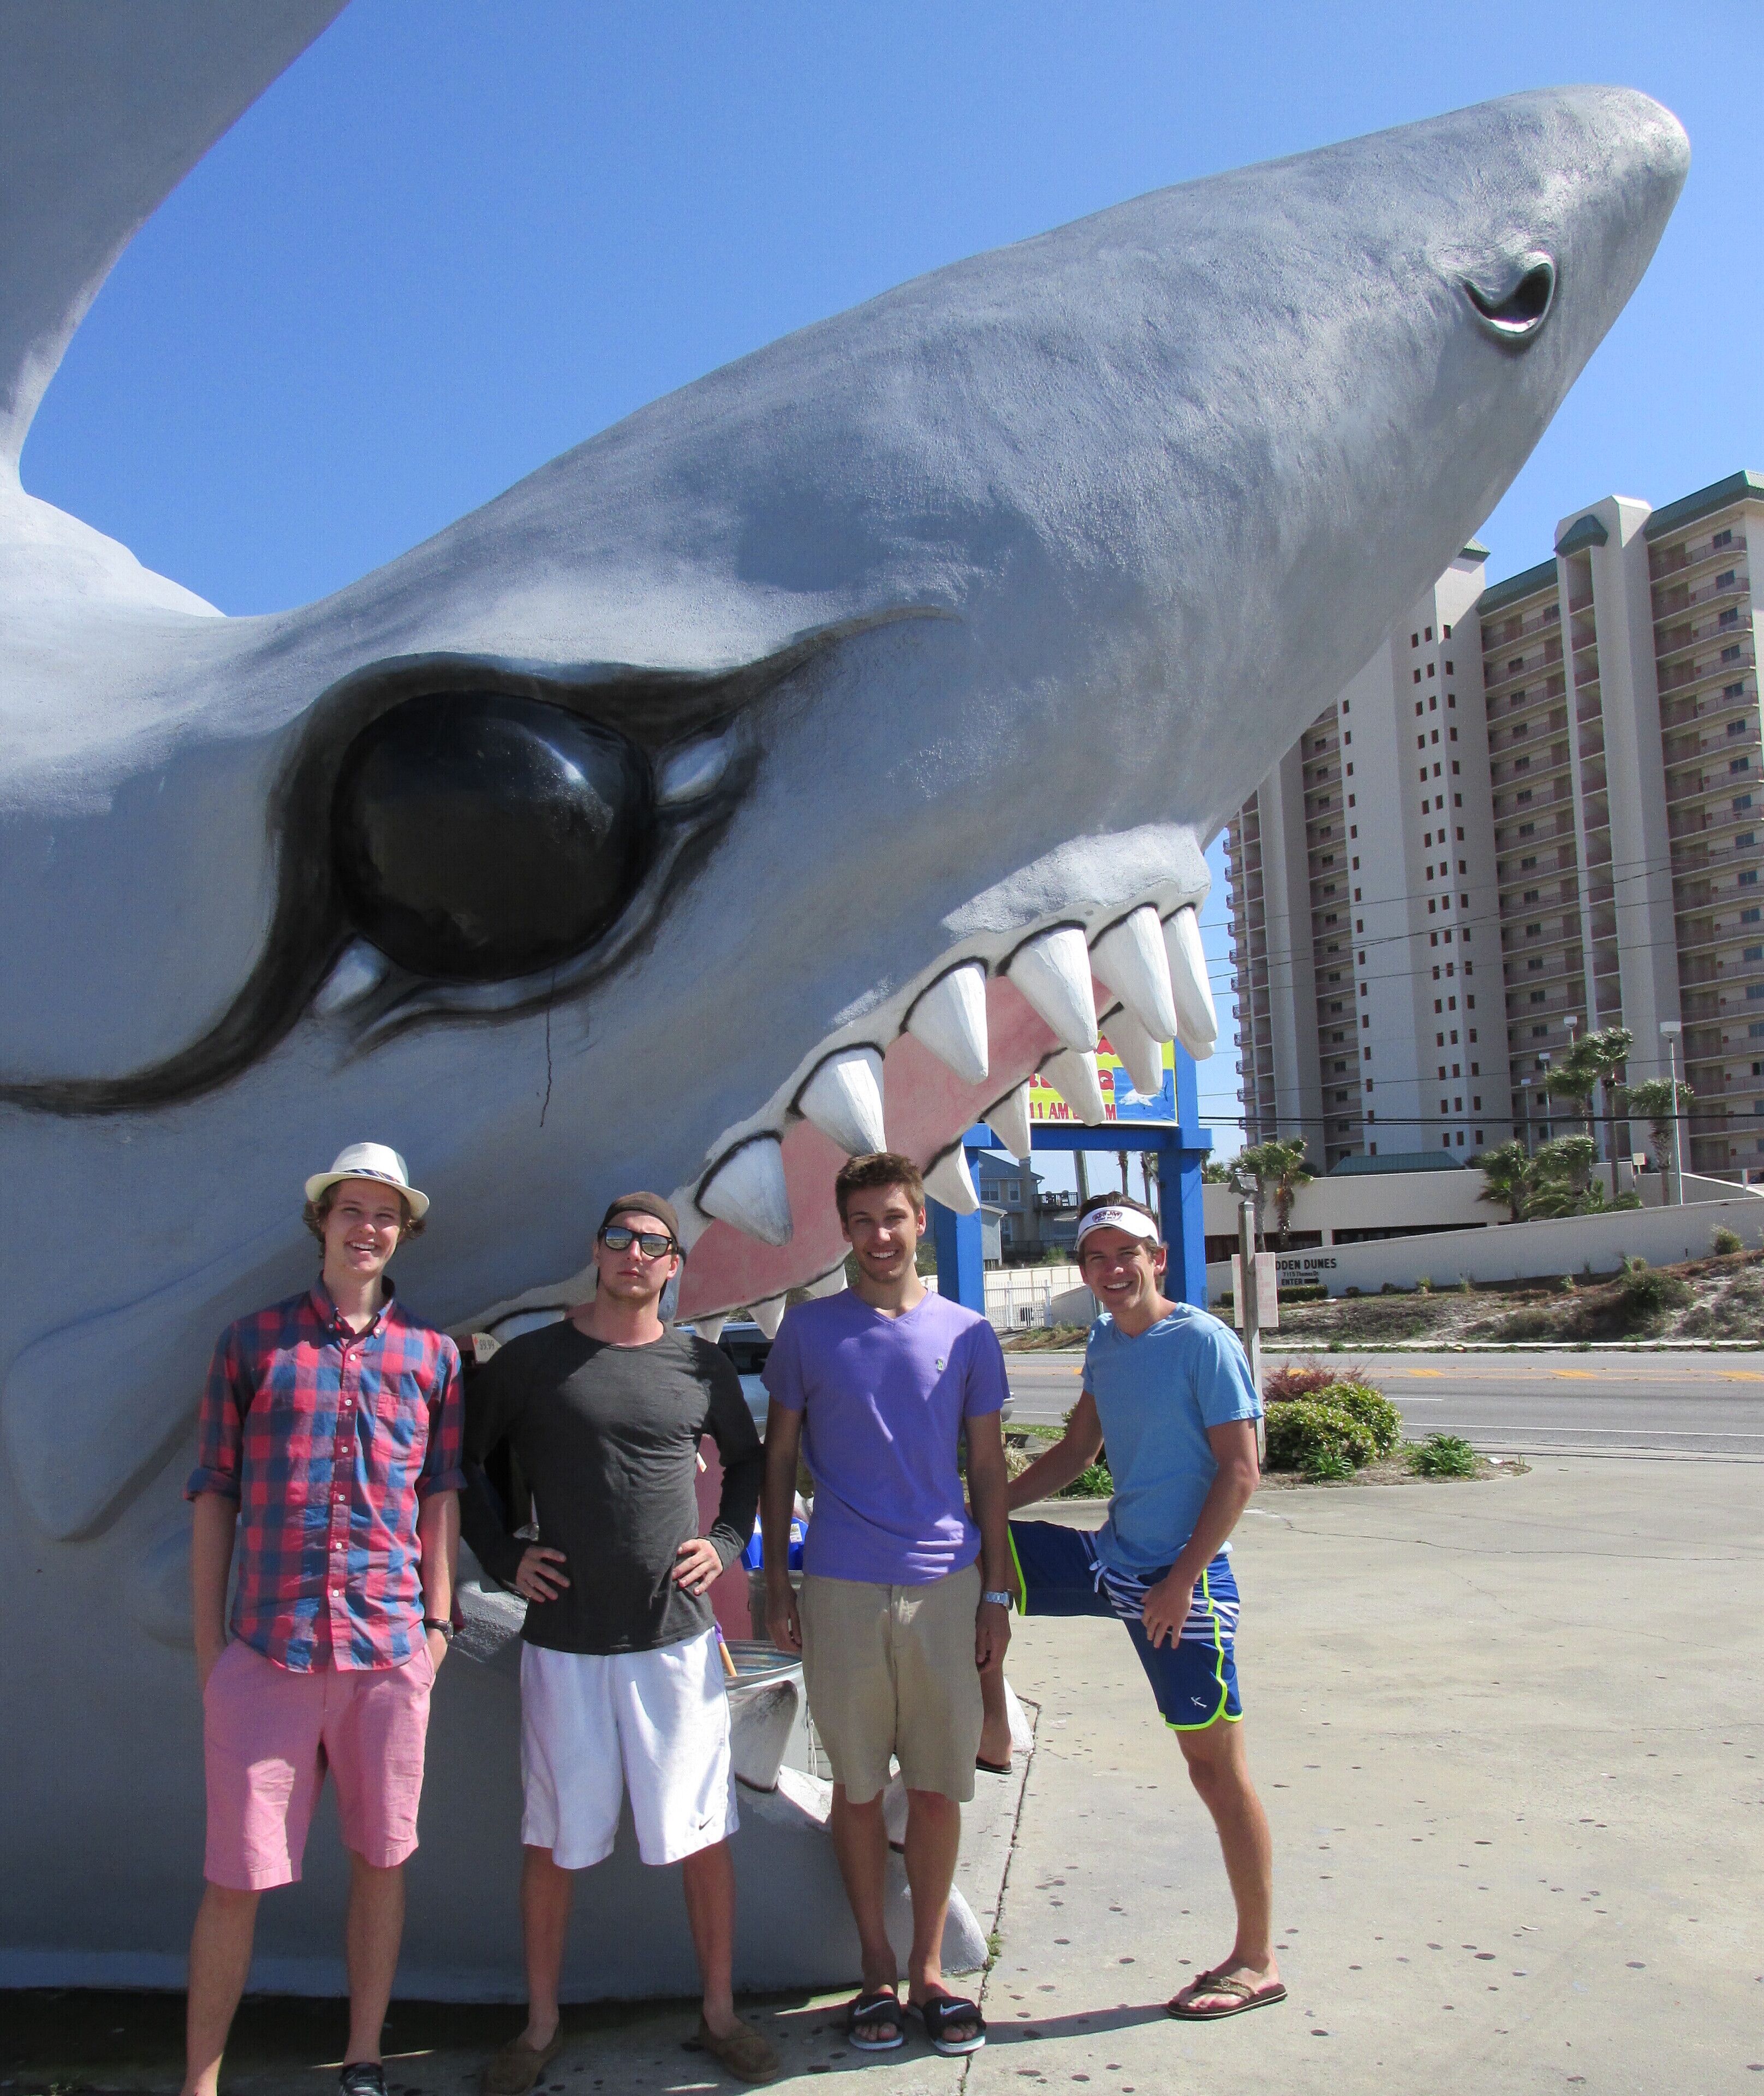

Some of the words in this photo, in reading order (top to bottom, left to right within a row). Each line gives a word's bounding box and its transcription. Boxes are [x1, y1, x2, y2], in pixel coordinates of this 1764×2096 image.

[1029, 1102, 1043, 1119] 11
[1048, 1103, 1069, 1120] AM
[1104, 1104, 1117, 1120] M
[1276, 1260, 1300, 1270] DDEN
[1304, 1258, 1337, 1269] DUNES
